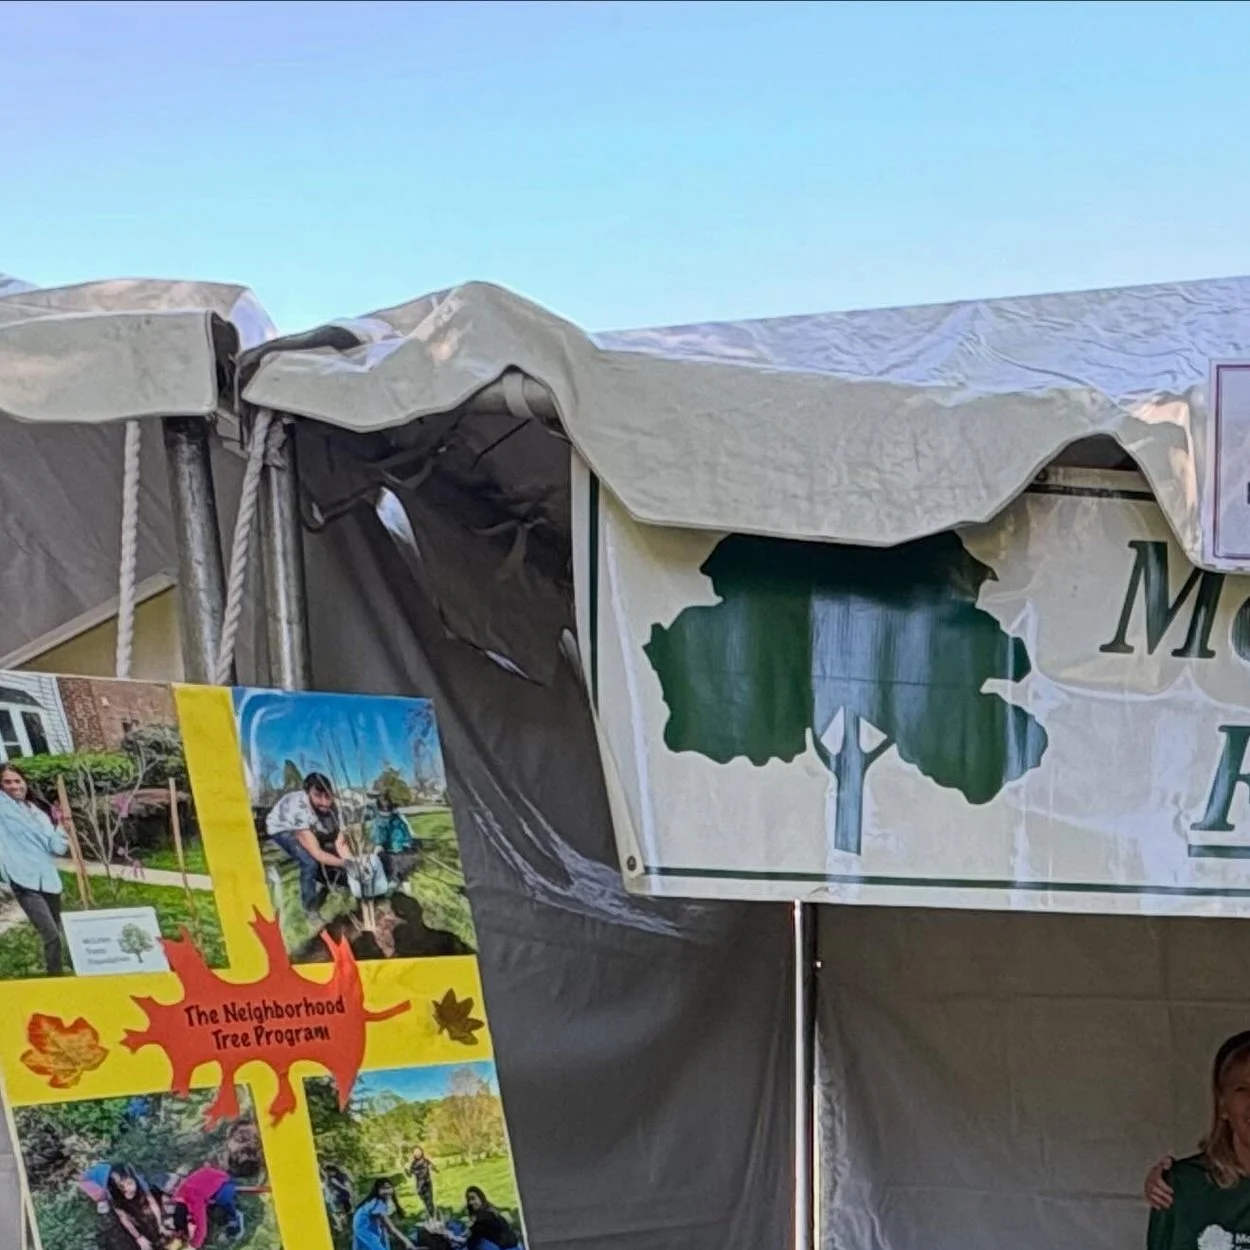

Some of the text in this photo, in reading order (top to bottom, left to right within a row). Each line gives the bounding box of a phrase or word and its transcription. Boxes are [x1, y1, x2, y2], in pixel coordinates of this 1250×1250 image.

[183, 994, 346, 1028] The Neighborhood
[211, 1024, 331, 1051] Tree Program
